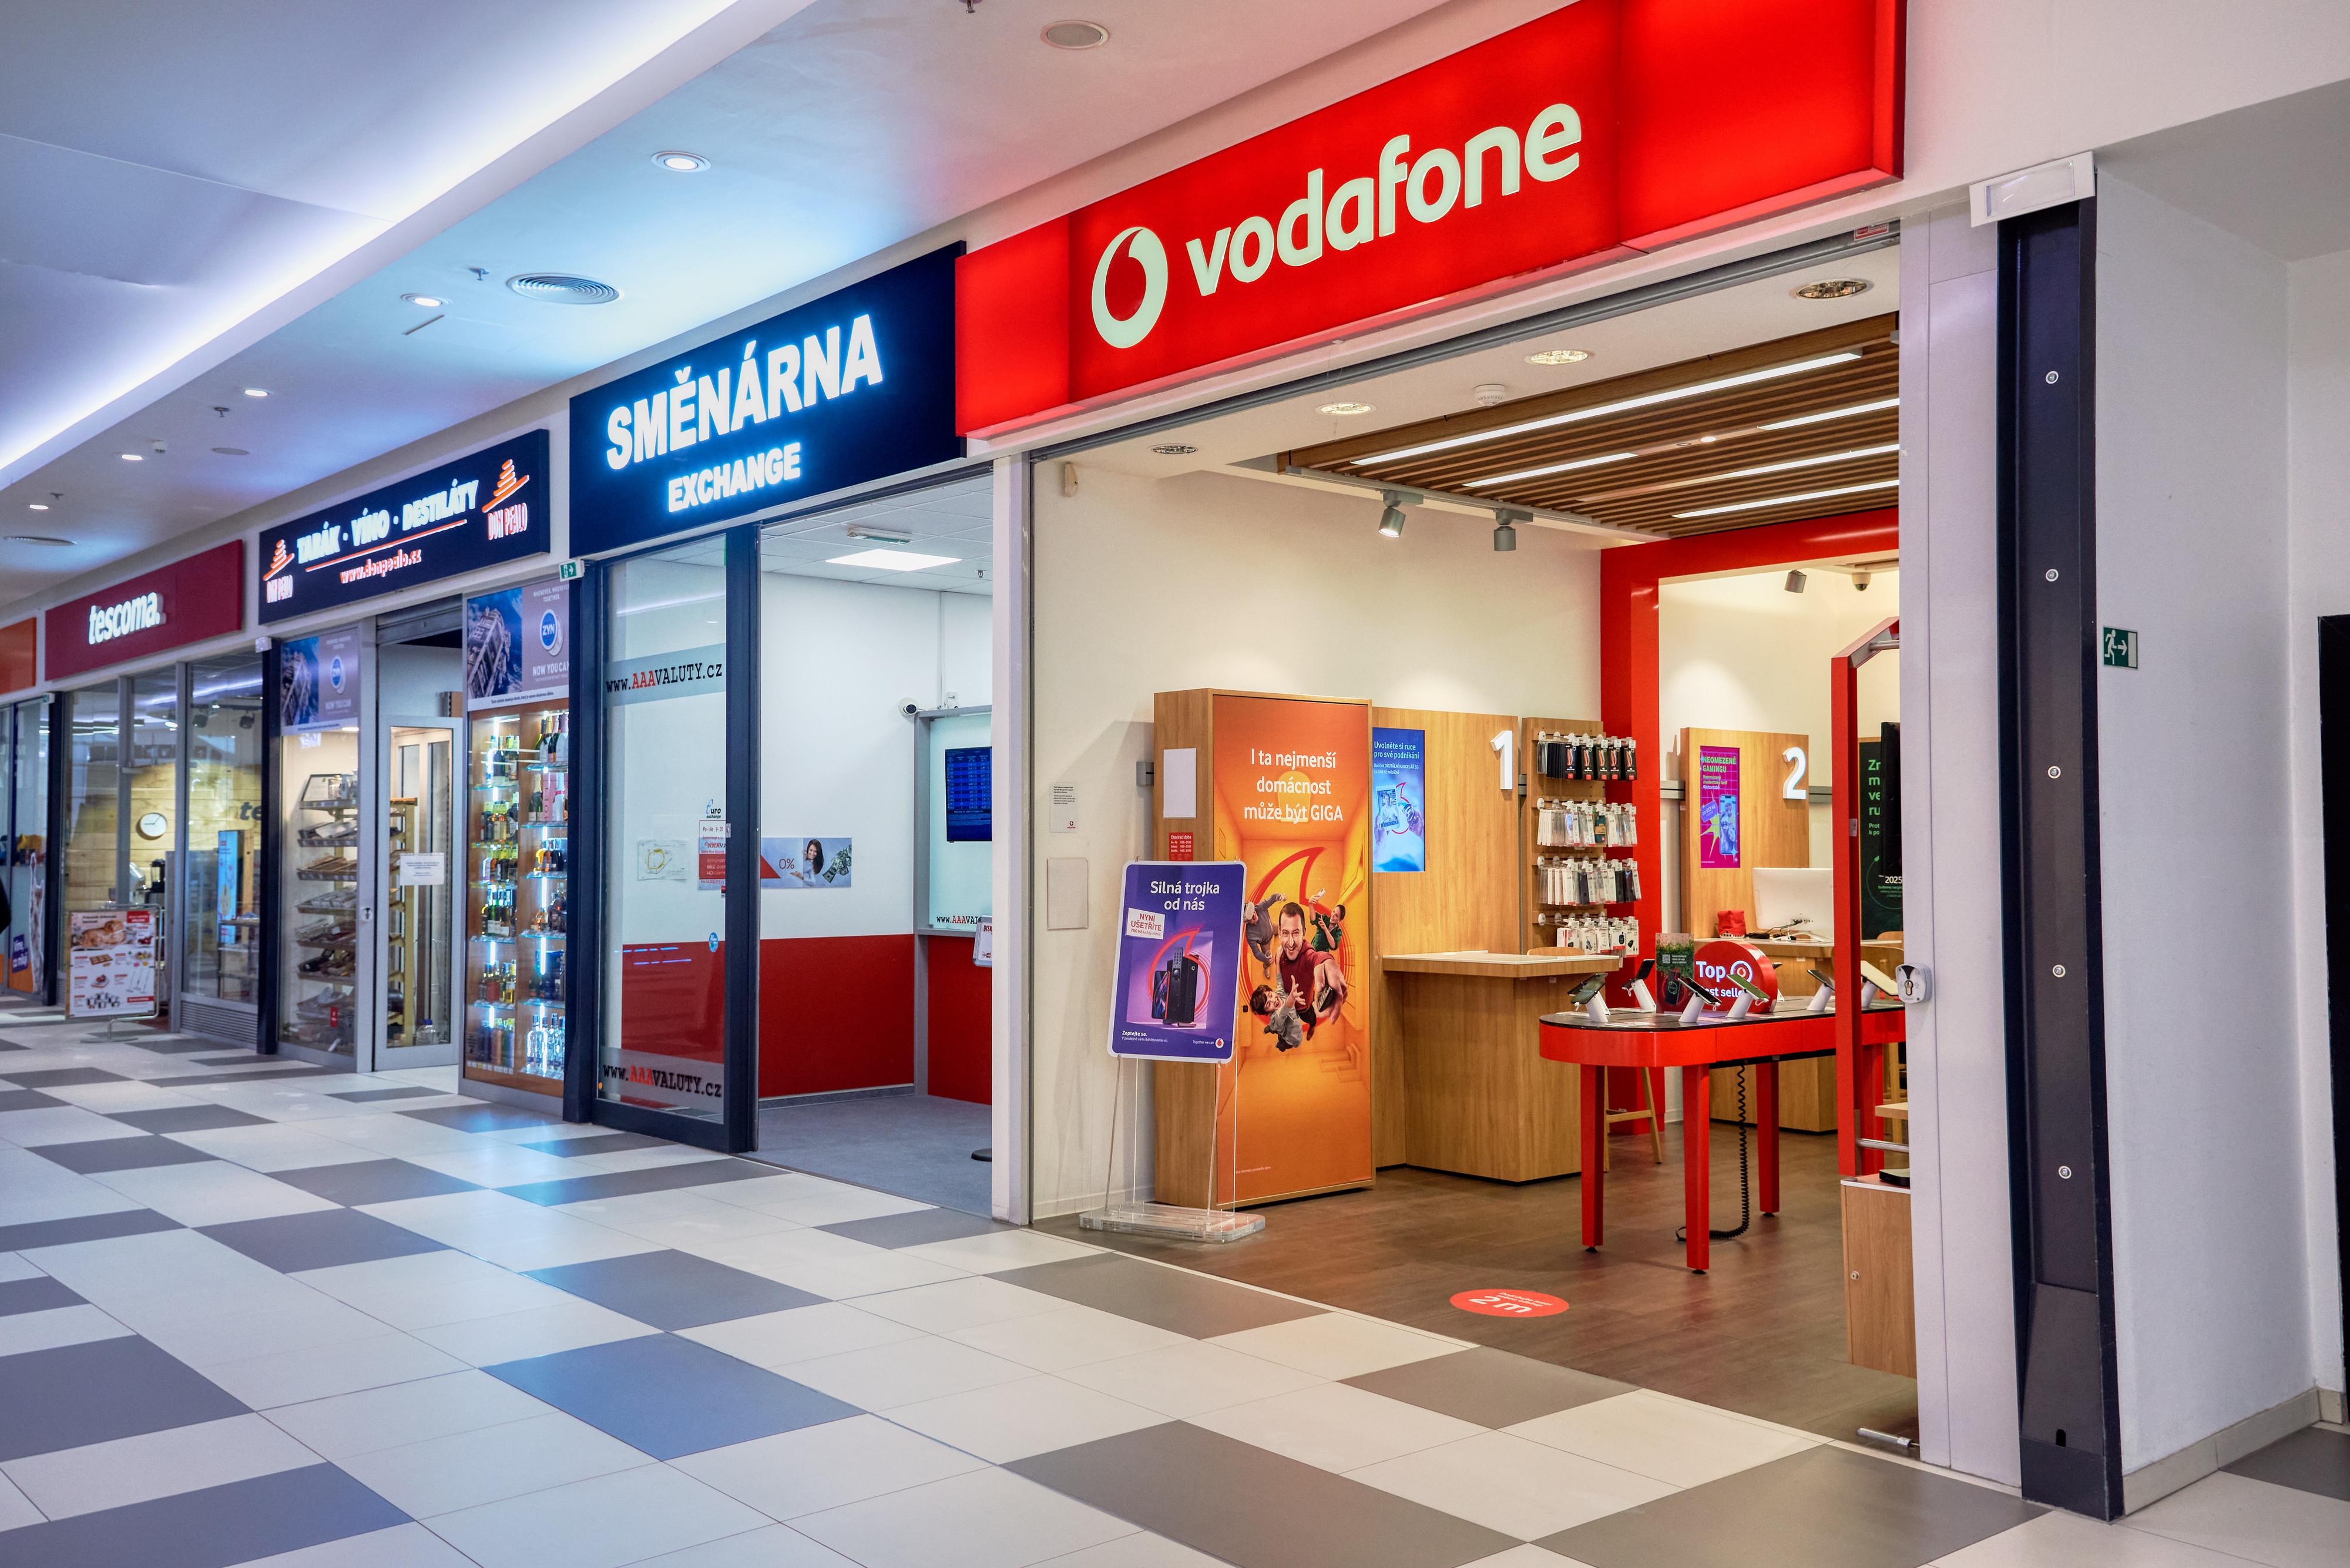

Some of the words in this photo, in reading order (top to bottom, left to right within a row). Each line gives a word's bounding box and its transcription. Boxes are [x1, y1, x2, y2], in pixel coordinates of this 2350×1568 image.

[1185, 103, 1582, 297] vodafone
[606, 313, 883, 471] SMĚNÁRNA
[668, 442, 801, 513] EXCHANGE
[297, 521, 341, 565] TABÁK
[351, 507, 390, 546] VÍNO
[402, 478, 479, 531] DESTILÁTY
[542, 624, 555, 636] ZYN
[533, 664, 546, 676] NOW
[547, 663, 558, 674] YOU
[606, 663, 723, 693] www.AAAVALUTY.cz
[1374, 741, 1398, 750] Uvolněte
[1251, 748, 1255, 765] I
[1258, 750, 1271, 765] ta
[1275, 750, 1337, 771] nejmenší
[1394, 751, 1419, 760] podnikání
[1490, 730, 1513, 790] 1
[1703, 765, 1727, 773] GAMINGU
[1782, 747, 1807, 800] 2
[1257, 776, 1331, 794] domácnost
[1244, 801, 1282, 820] může
[1285, 803, 1307, 824] být
[1310, 804, 1344, 821] GIGA
[779, 858, 795, 869] 0%
[1150, 881, 1182, 894] Silná
[1186, 881, 1220, 897] trojka
[1885, 876, 1902, 884] 2025
[1164, 898, 1180, 911] od
[1183, 898, 1205, 911] nás
[1131, 919, 1161, 931] UŠETŘÍTE
[1140, 913, 1156, 922] NYNÍ
[1696, 961, 1726, 983] Top
[1721, 988, 1744, 998] selle
[603, 1064, 723, 1098] www.AAAVALUTY.cz
[1468, 1295, 1501, 1305] 2
[1493, 1302, 1532, 1313] m
